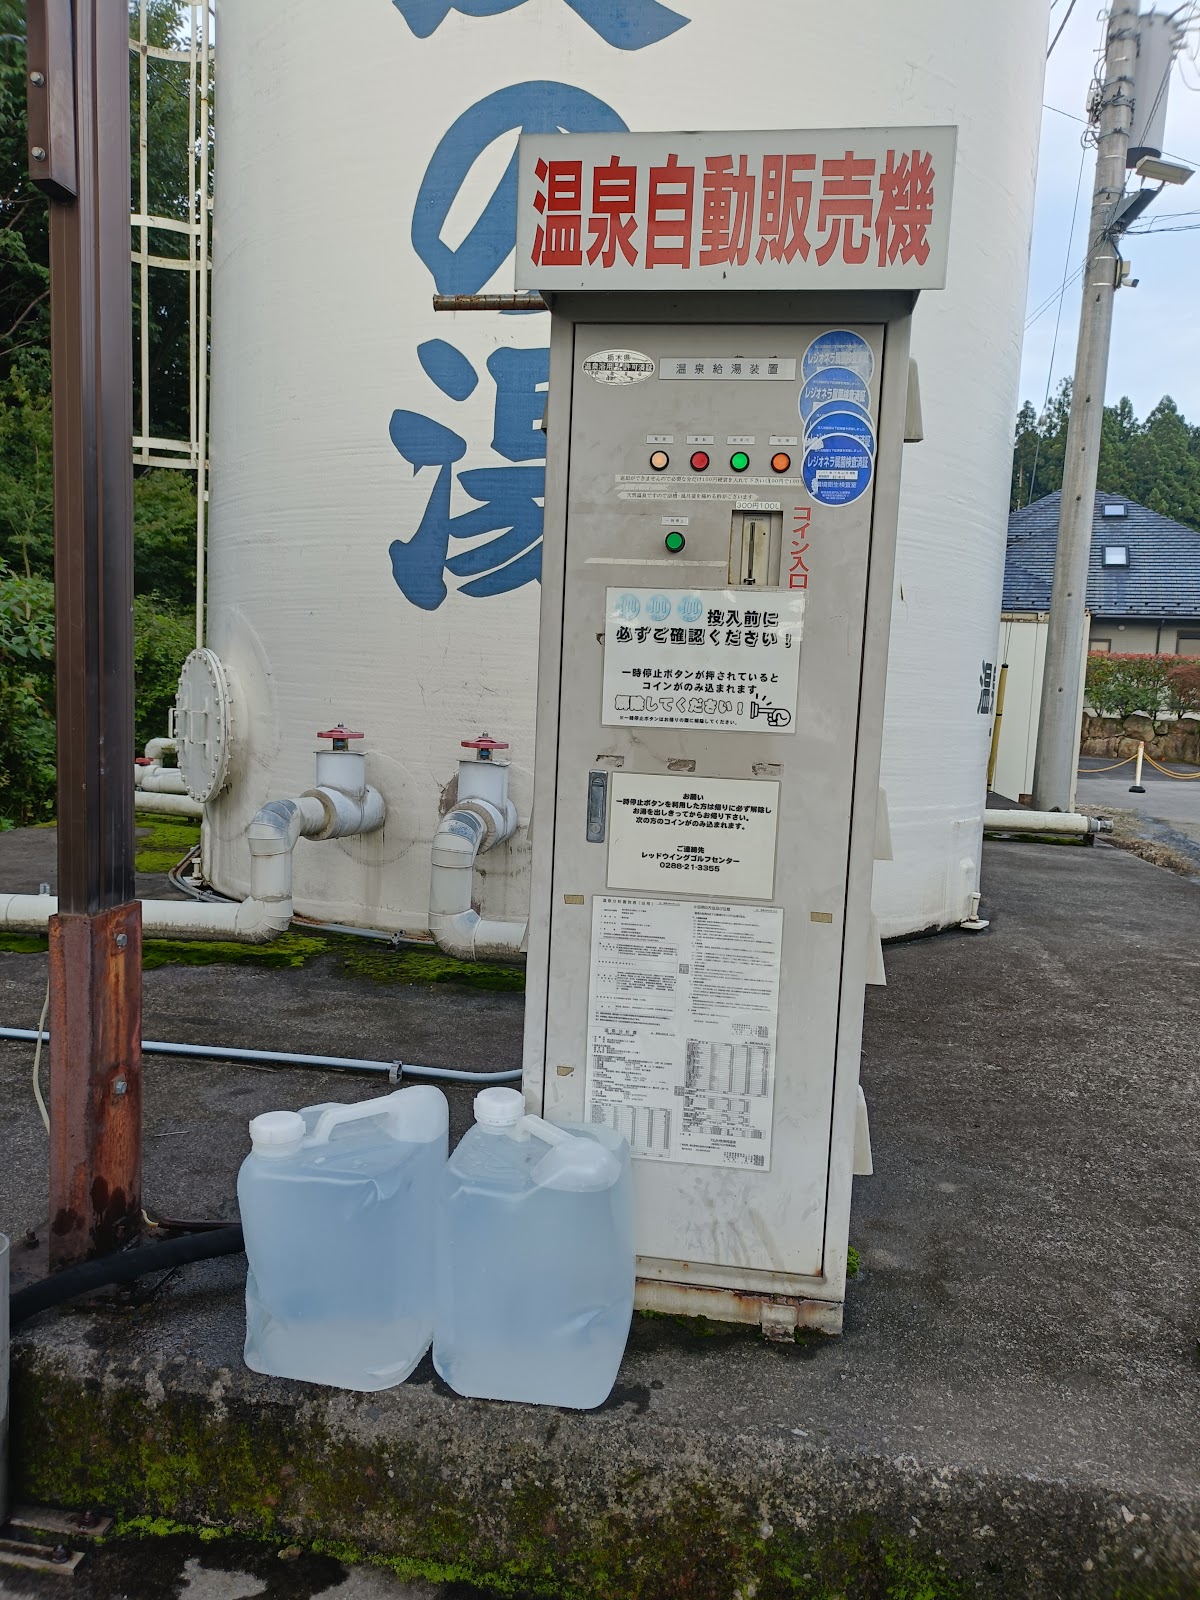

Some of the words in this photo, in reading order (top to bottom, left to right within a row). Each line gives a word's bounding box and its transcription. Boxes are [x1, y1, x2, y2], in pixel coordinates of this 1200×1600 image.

[531, 150, 935, 269] 温泉自動販売機
[676, 363, 779, 375] 温泉給湯装置
[736, 502, 780, 510] 300円100L
[789, 507, 811, 589] コイン入口
[707, 609, 779, 627] 投入前に
[622, 668, 779, 683] 一時停止ボタンが押されていると
[682, 793, 704, 801] お願い
[616, 798, 772, 814] 一時停止ボタンを利用した方は帰りに必ず解除し
[632, 807, 750, 822] お湯を出しきってからお帰り下さい。
[635, 816, 746, 830] 次の方のコインがのみ込まれます。
[676, 845, 705, 854] ご連絡先
[641, 851, 740, 864] レッドウイングゴルフセンター
[659, 861, 720, 872] 0288-21-3355
